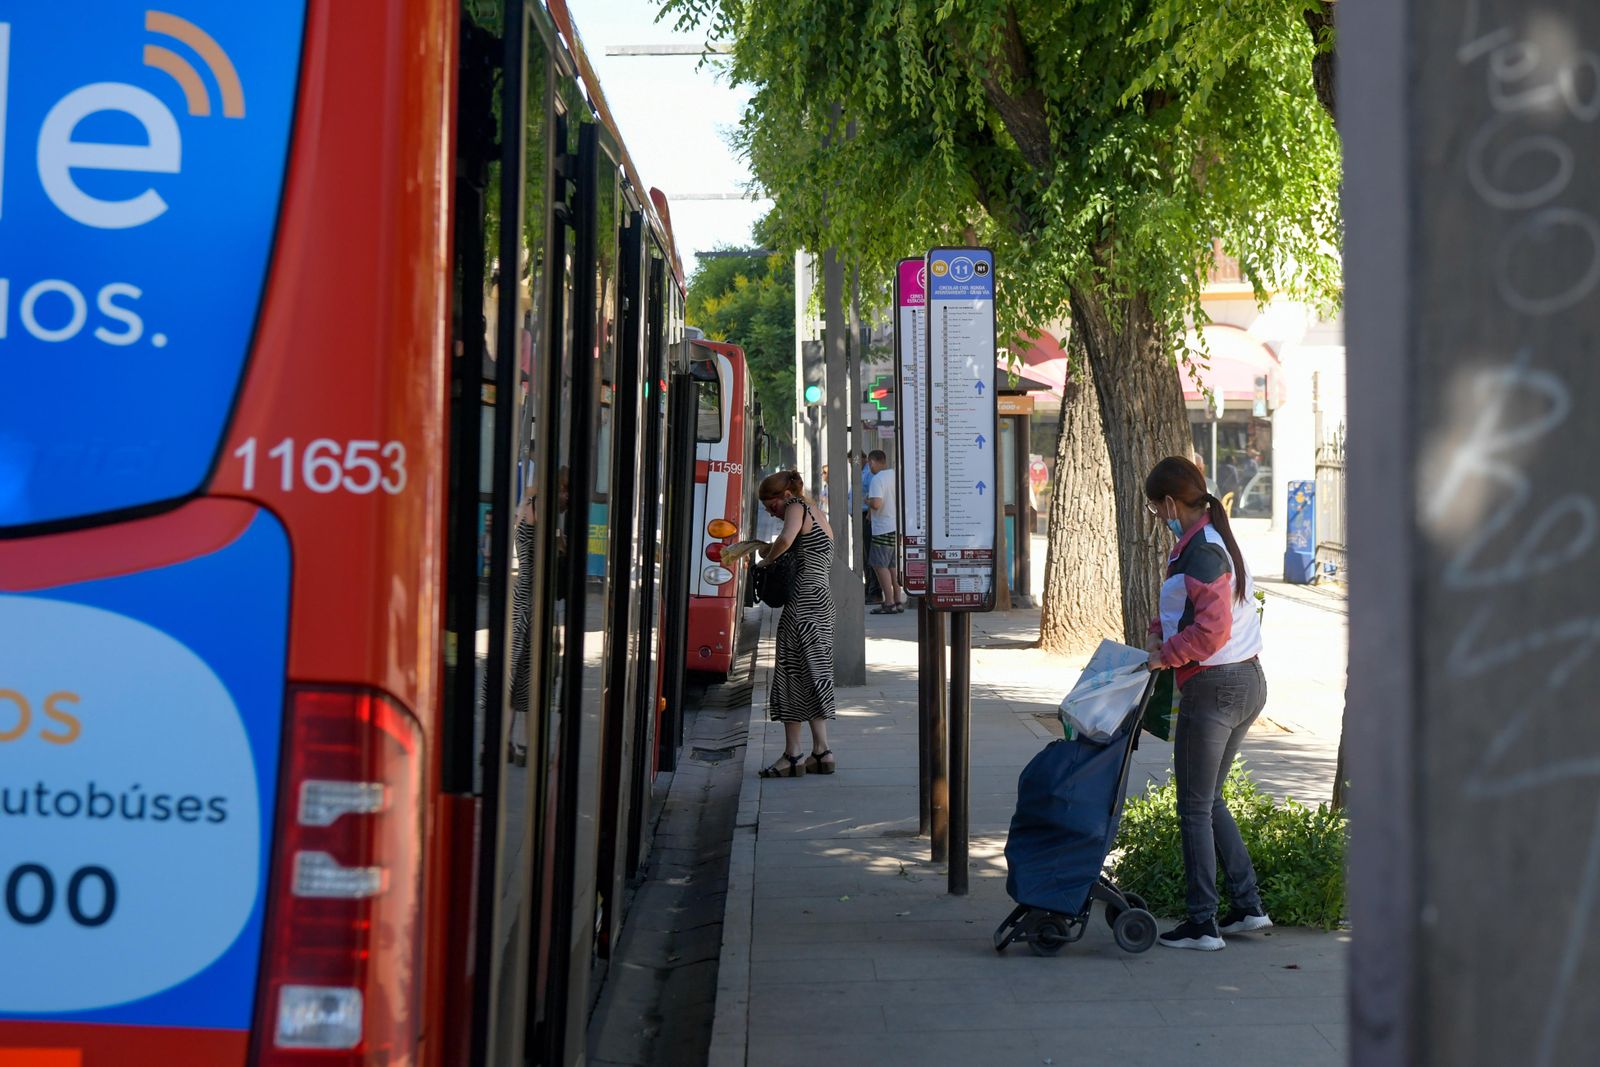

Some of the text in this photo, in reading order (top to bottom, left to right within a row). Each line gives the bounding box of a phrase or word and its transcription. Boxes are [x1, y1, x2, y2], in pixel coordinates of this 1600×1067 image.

[954, 265, 968, 275] 11
[233, 437, 407, 495] 11653
[710, 461, 743, 475] 11599
